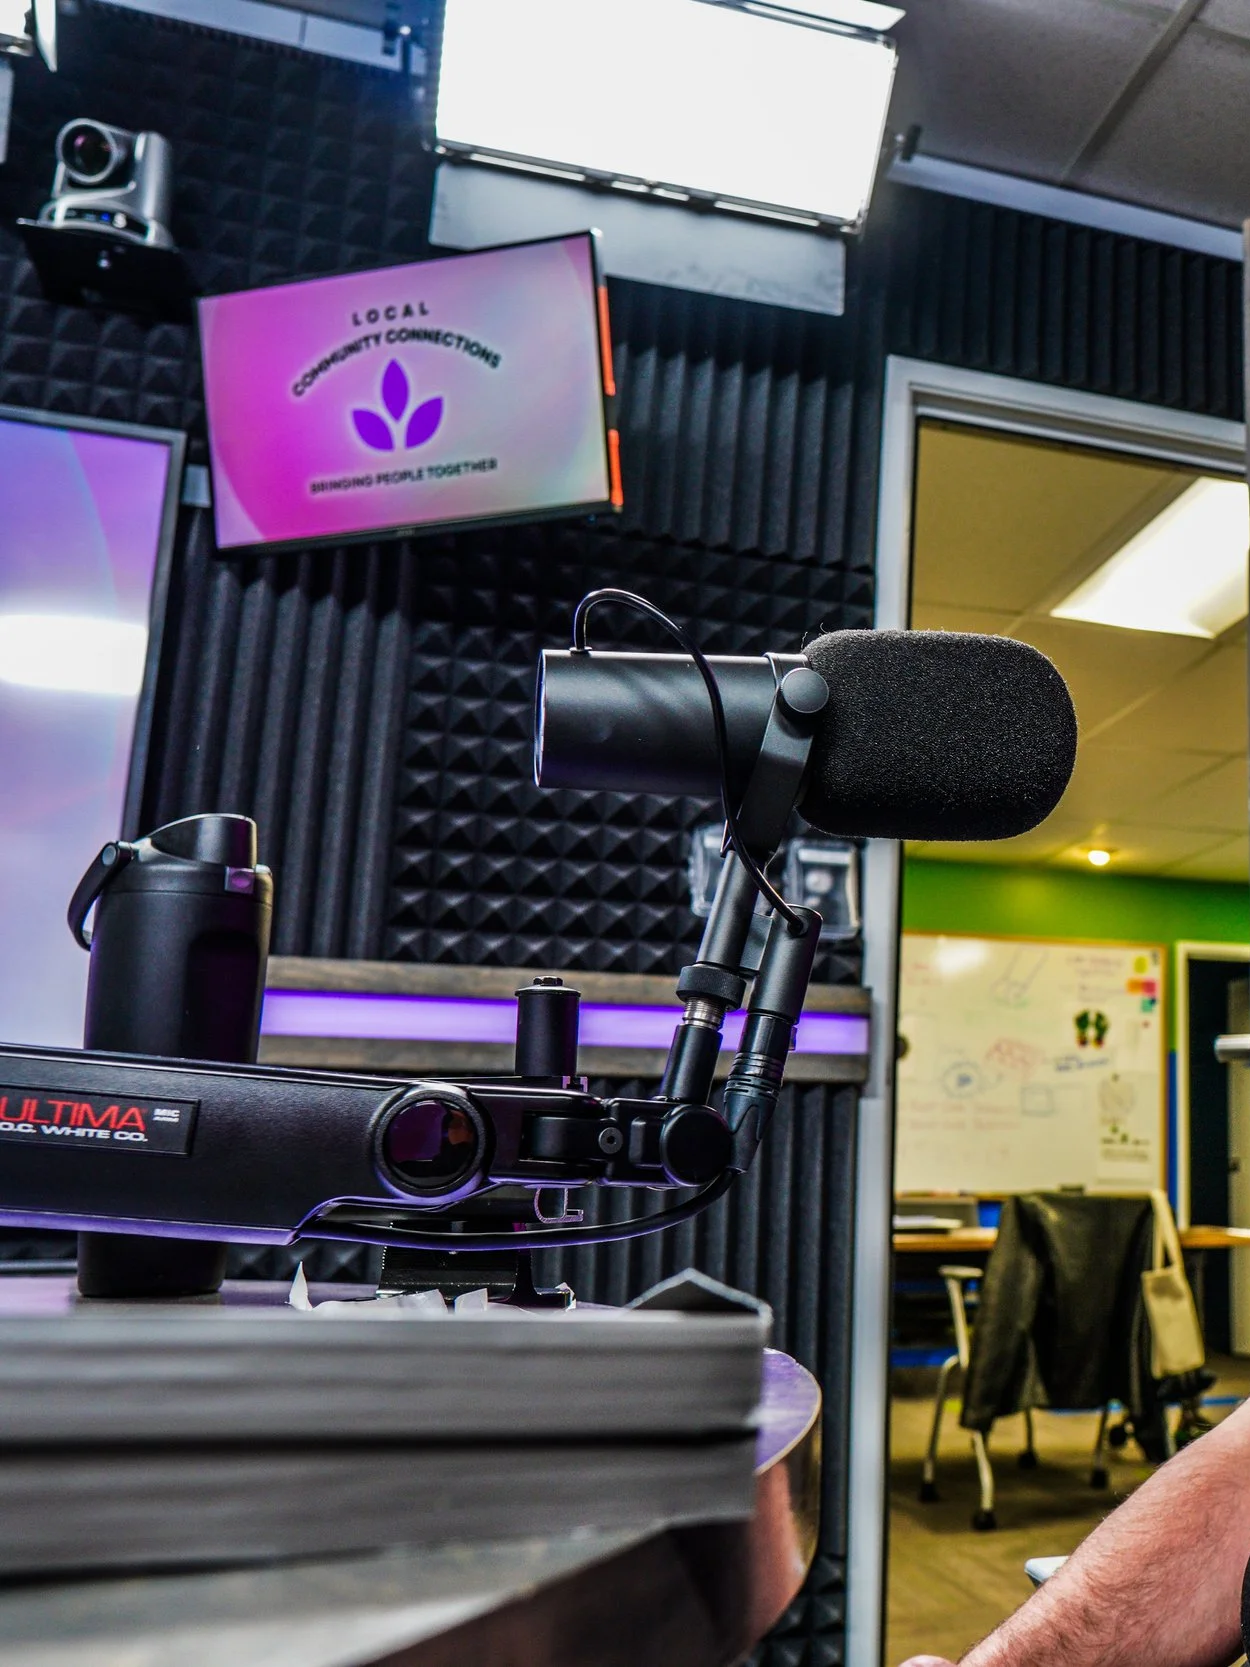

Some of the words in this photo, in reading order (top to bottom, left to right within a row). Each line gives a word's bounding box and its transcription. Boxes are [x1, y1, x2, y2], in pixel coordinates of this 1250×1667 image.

[352, 302, 429, 326] LOCAL
[292, 331, 382, 397] COMMUNITY
[385, 327, 502, 369] CONNECTIONS
[311, 473, 373, 494] BRINGING
[376, 466, 424, 484] PEOPLE
[427, 457, 498, 478] TOGETHER
[0, 1096, 146, 1132] ULTIMA
[41, 1125, 111, 1139] WHITE
[113, 1130, 148, 1141] CO.
